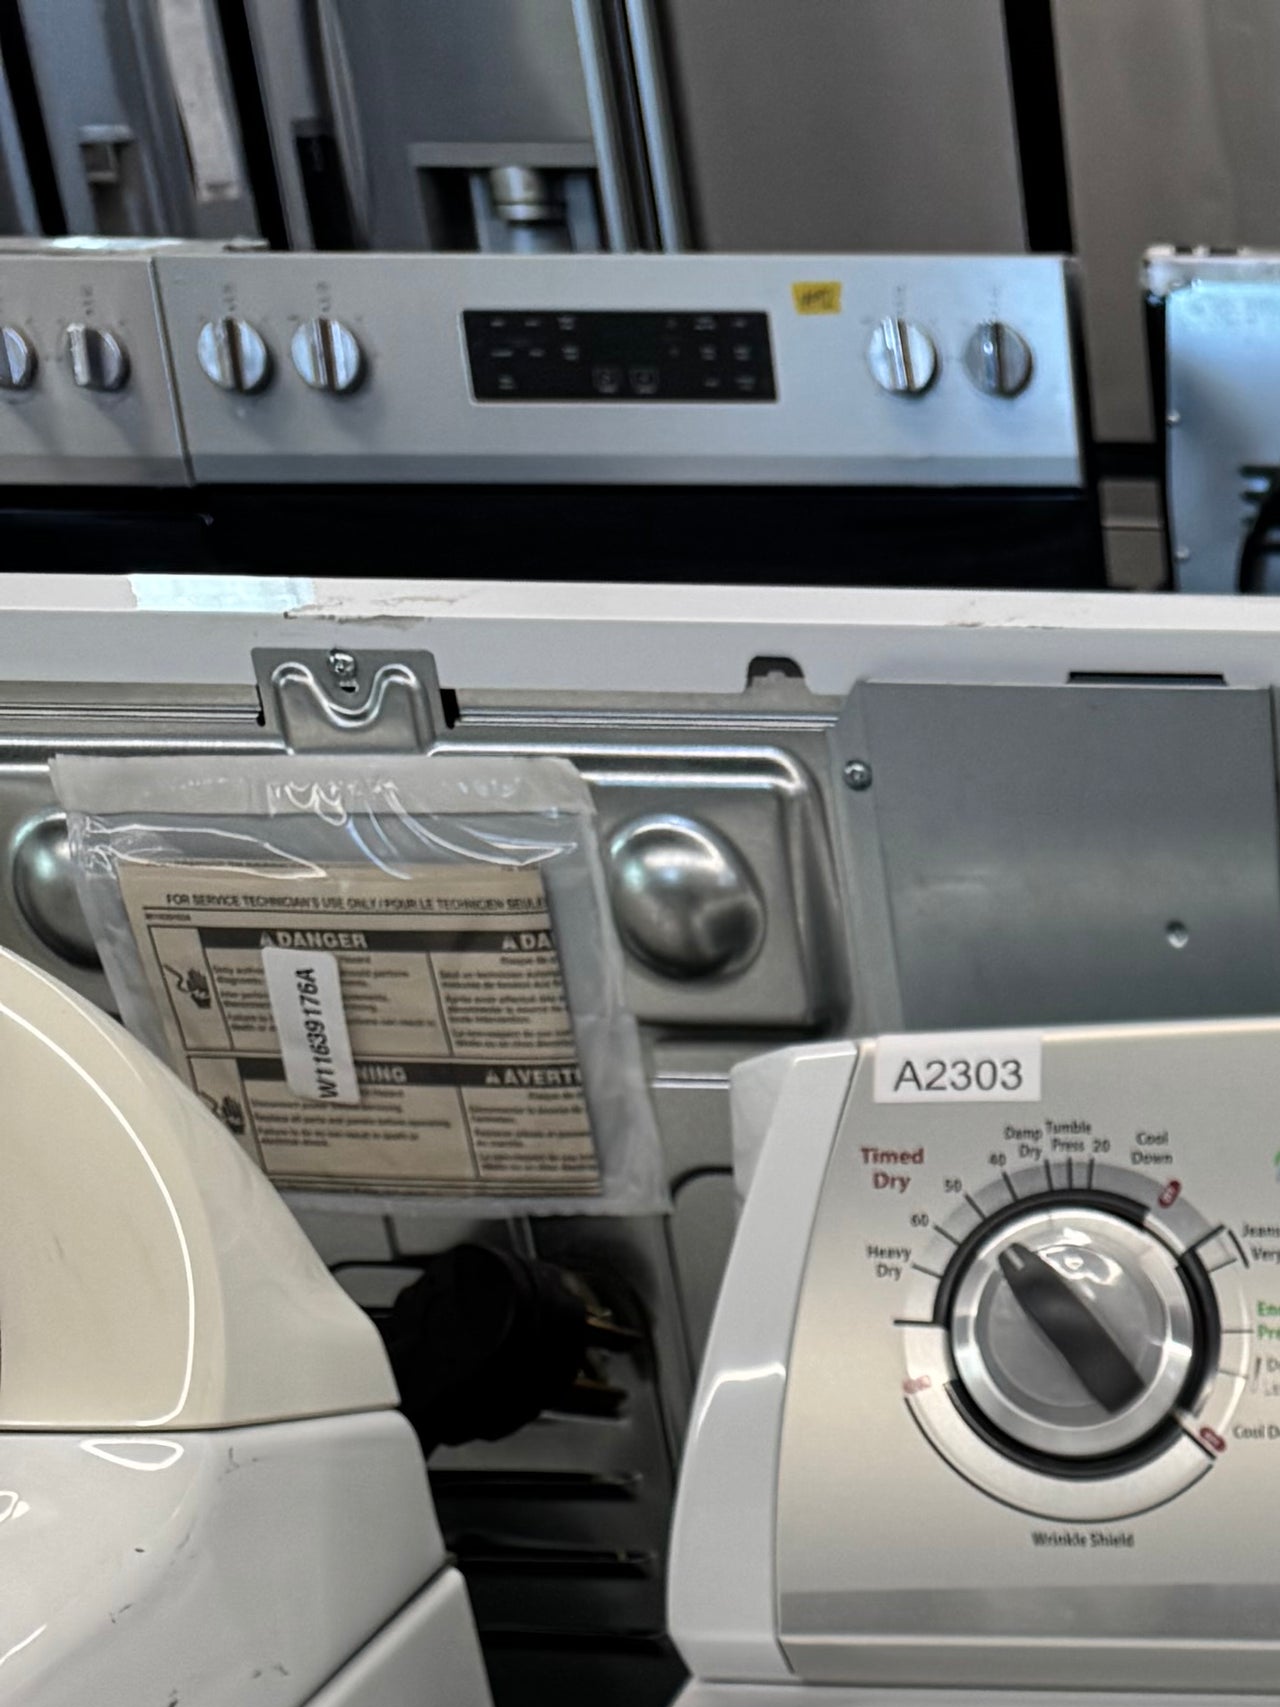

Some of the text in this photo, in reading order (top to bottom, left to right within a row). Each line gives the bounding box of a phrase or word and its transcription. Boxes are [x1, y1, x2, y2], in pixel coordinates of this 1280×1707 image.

[276, 931, 368, 949] DANGER
[295, 967, 339, 1098] W11639176A
[893, 1060, 1024, 1092] A2303
[1004, 1126, 1043, 1142] Damp
[1045, 1120, 1092, 1134] Tumble
[1092, 1139, 1111, 1153] 20
[1135, 1131, 1169, 1146] Cool
[861, 1146, 925, 1166] Timed
[1019, 1144, 1043, 1161] Dry
[1131, 1151, 1173, 1165] Down
[873, 1171, 911, 1193] Dry
[944, 1178, 962, 1194] 50
[910, 1213, 930, 1228] 60
[866, 1245, 912, 1262] Heavy
[876, 1263, 903, 1281] Dry
[1232, 1425, 1265, 1439] Cool
[1031, 1531, 1136, 1547] Wrinkle Shield
